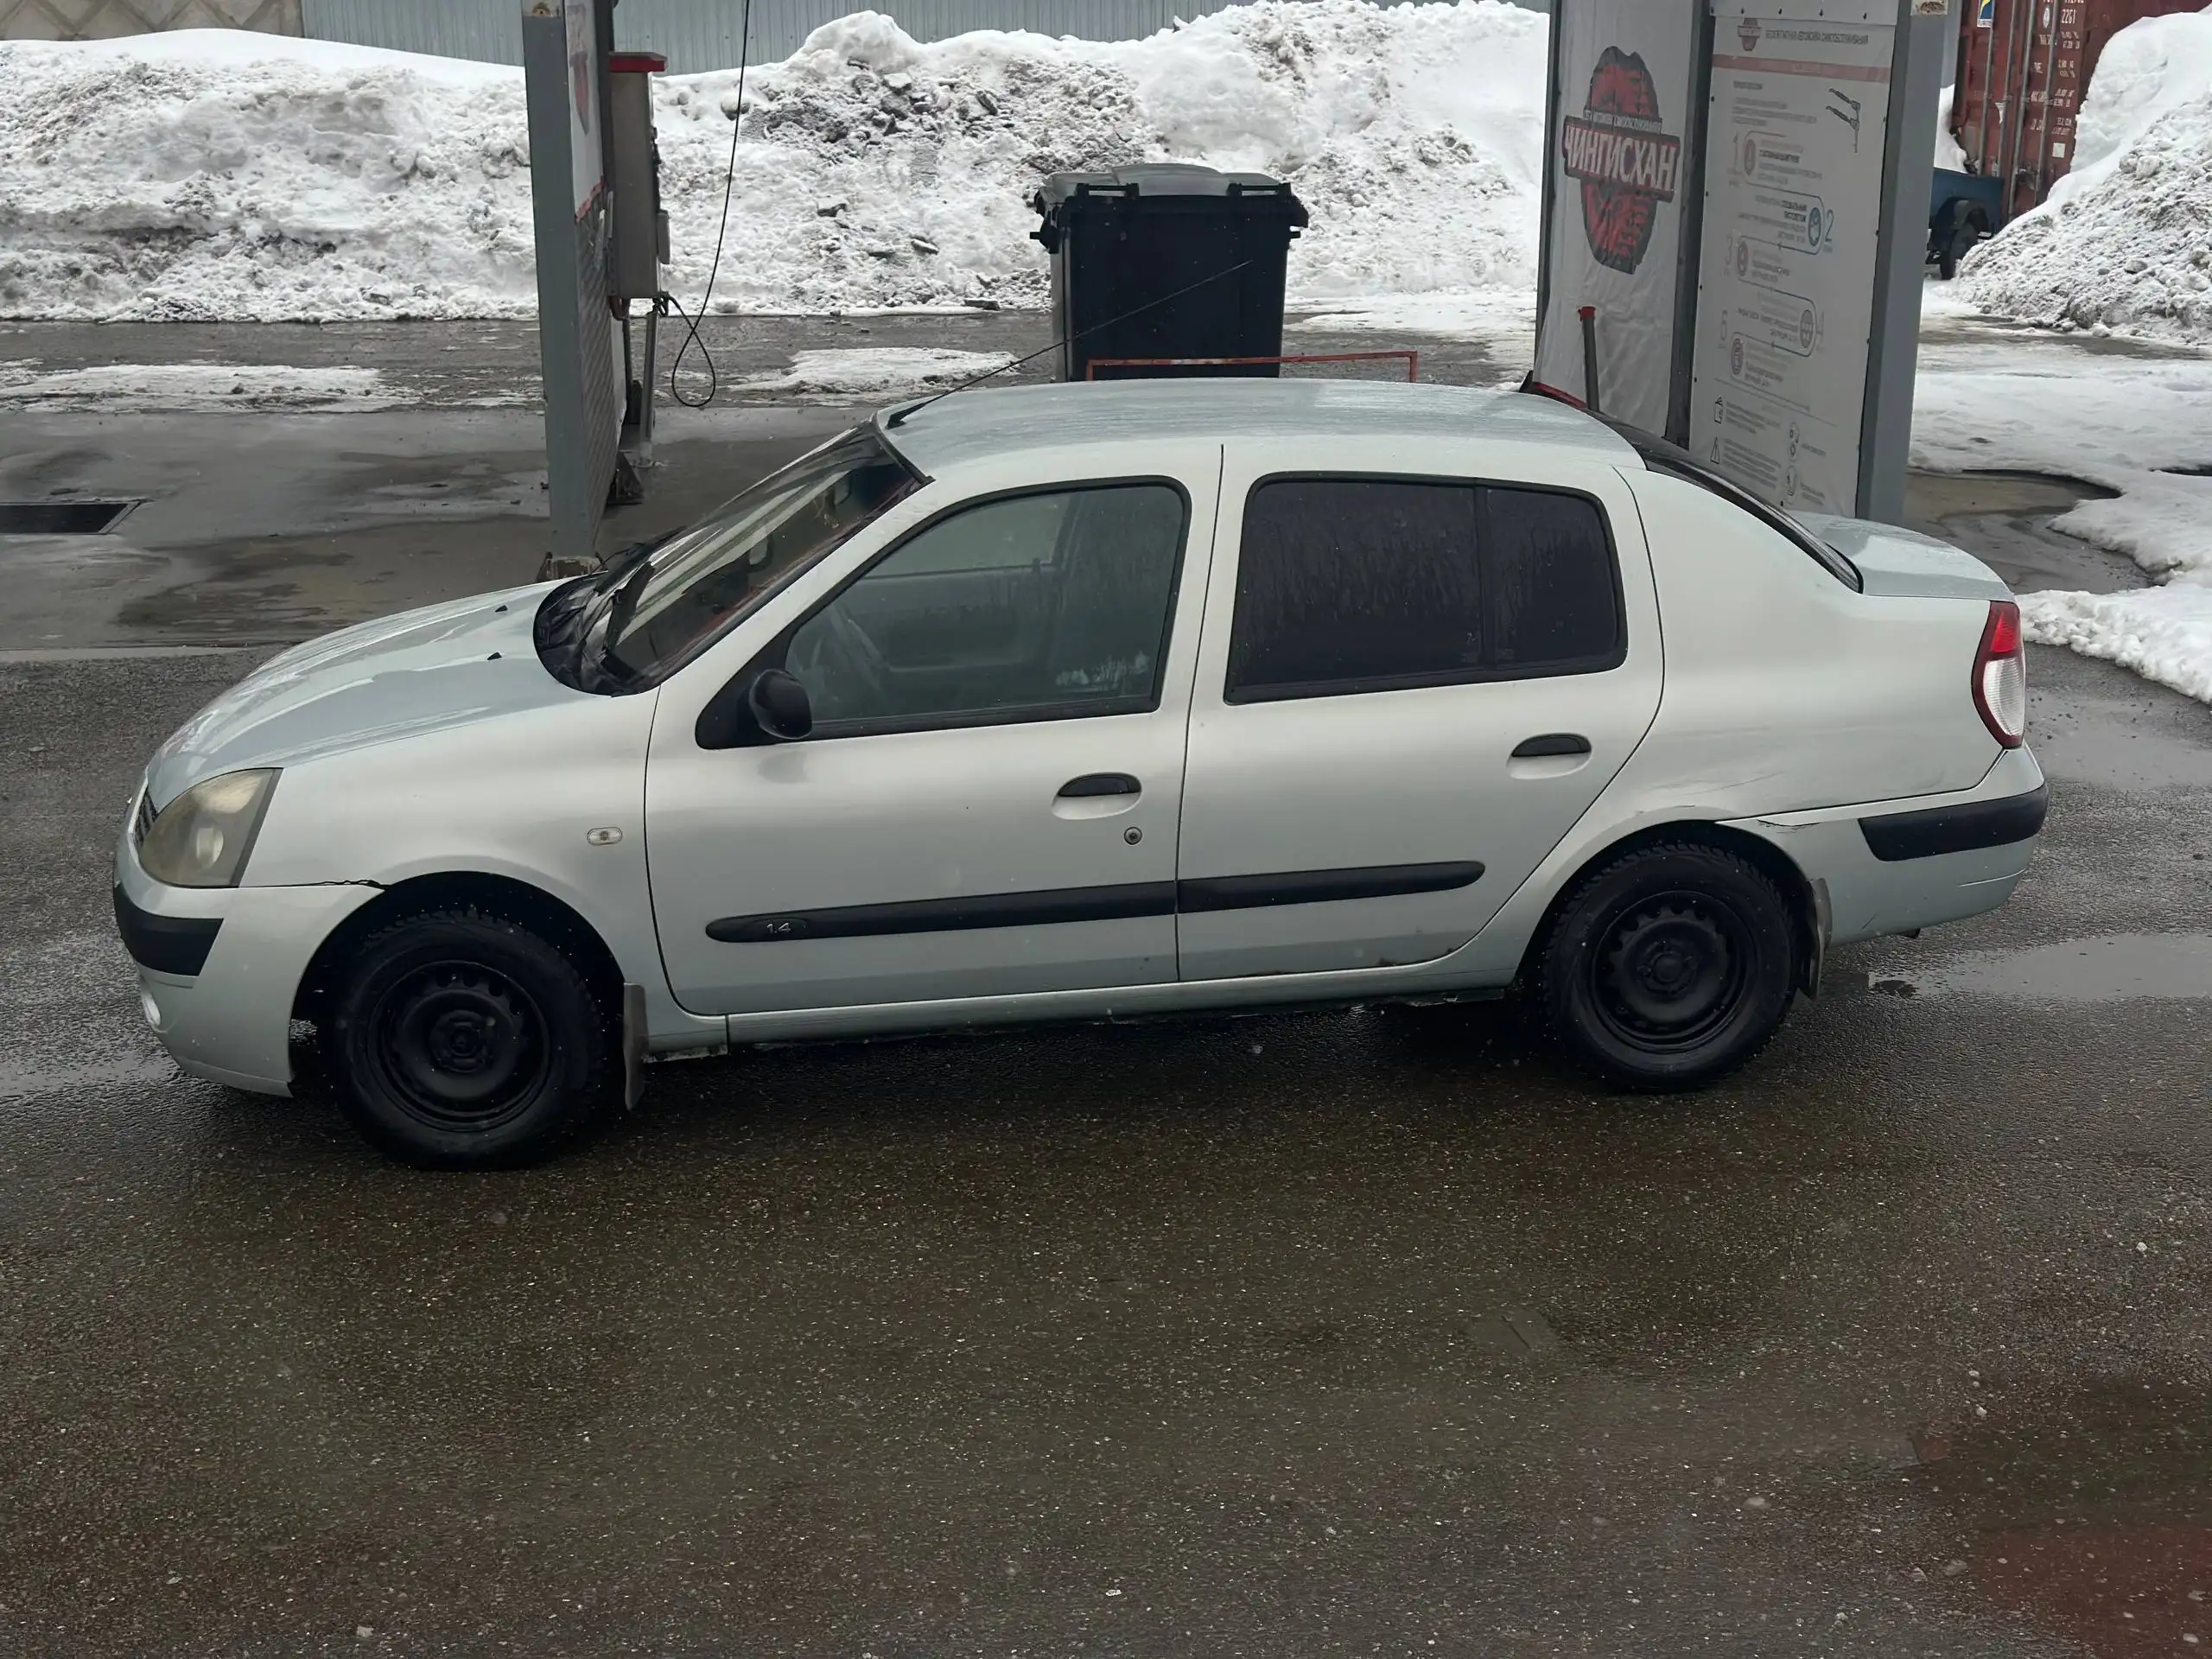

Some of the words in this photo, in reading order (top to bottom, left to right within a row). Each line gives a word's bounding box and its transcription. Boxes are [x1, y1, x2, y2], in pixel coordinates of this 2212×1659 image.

[1564, 124, 1677, 191] ЧИНГИСХАН
[1824, 209, 1834, 242] 2
[766, 922, 791, 933] 1.4
